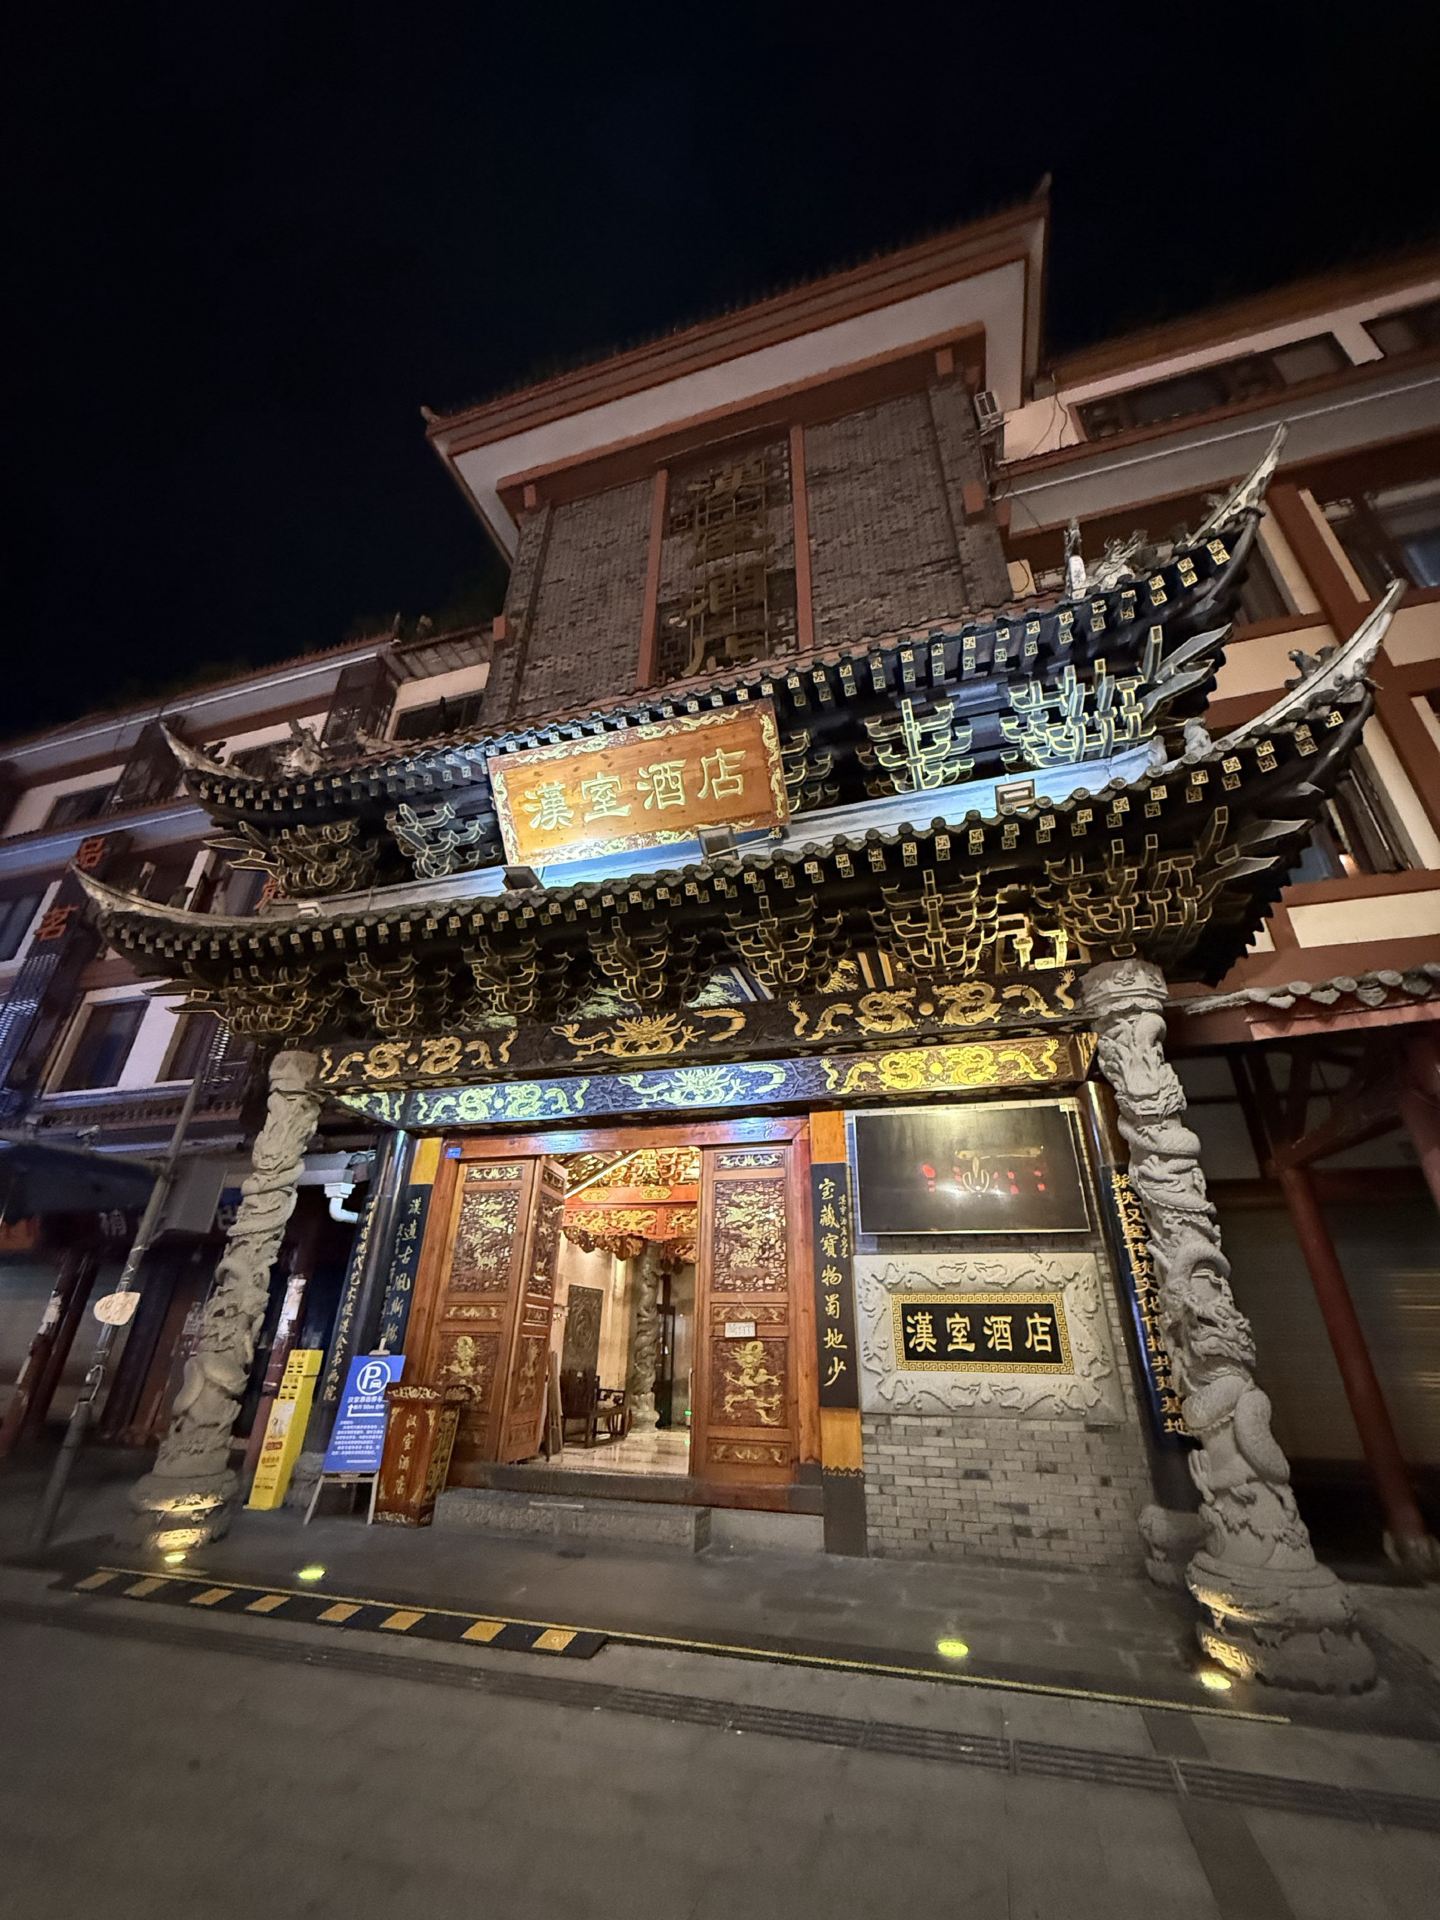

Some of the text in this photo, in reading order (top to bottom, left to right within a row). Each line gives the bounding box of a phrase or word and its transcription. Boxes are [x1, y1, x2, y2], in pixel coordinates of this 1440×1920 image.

[522, 748, 746, 831] 漢室酒店
[906, 1312, 1052, 1353] 漢室酒店
[362, 1366, 381, 1389] P
